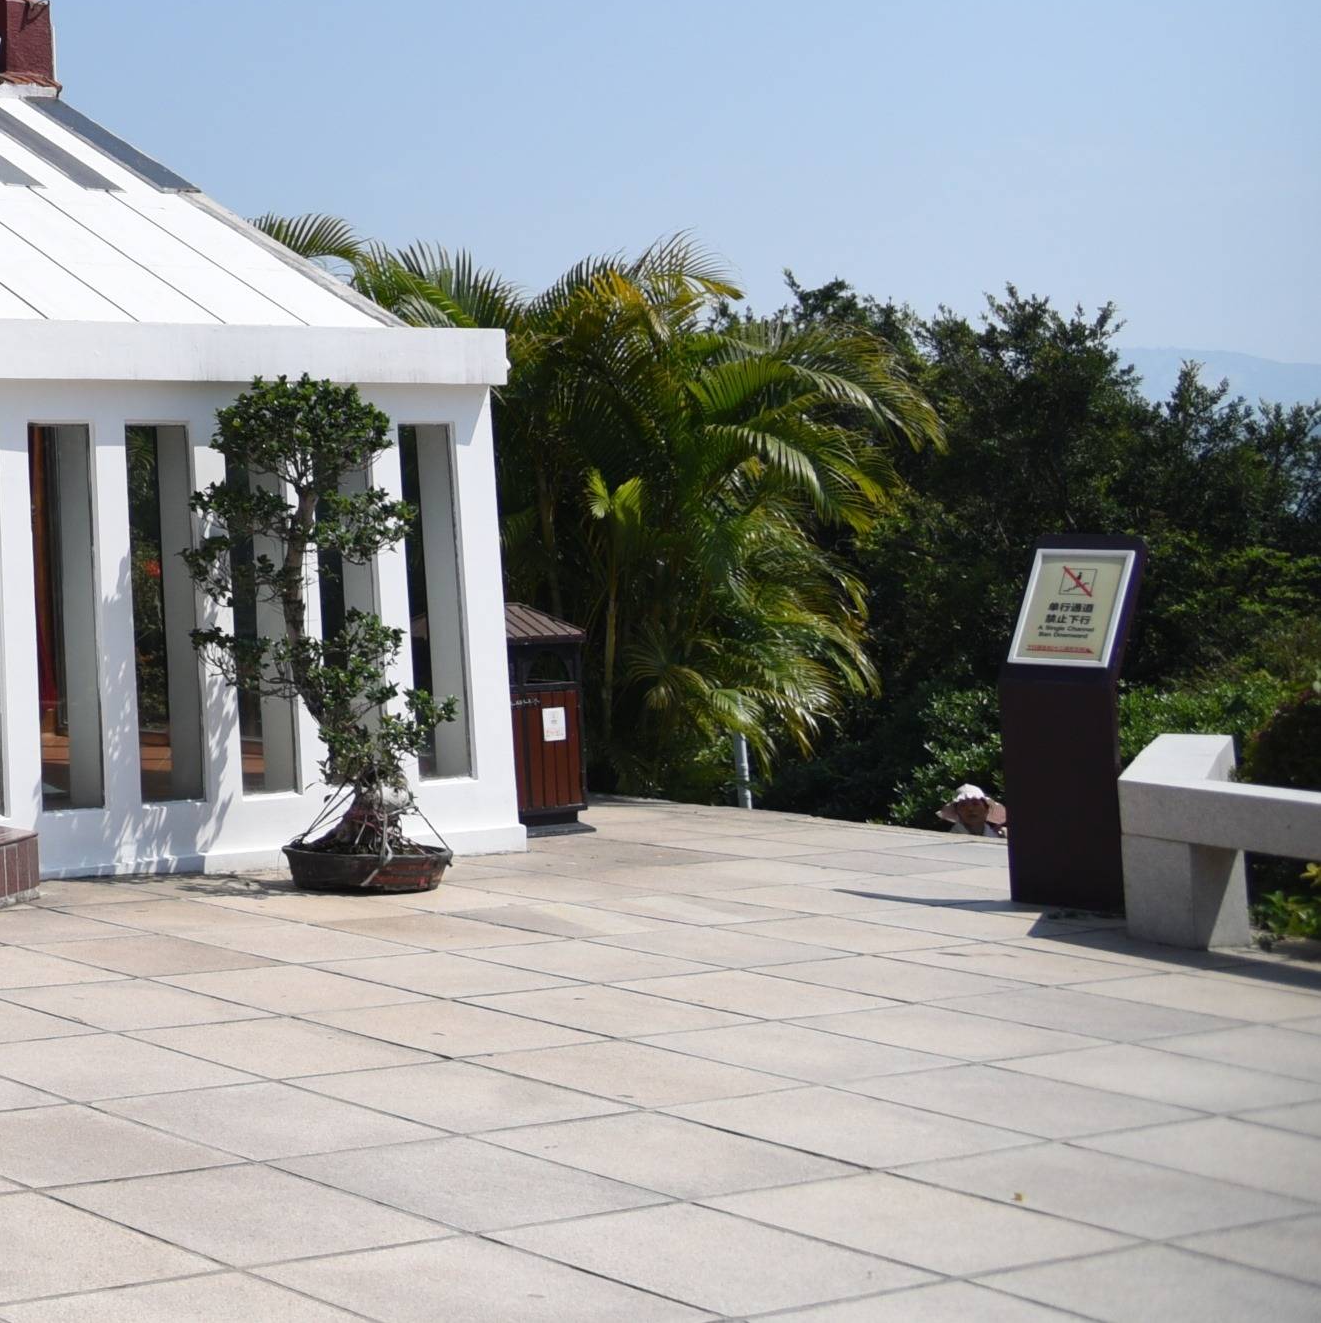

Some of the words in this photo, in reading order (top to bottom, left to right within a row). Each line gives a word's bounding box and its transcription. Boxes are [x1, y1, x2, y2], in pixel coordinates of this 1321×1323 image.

[1048, 602, 1094, 612] 单行通道
[1045, 614, 1091, 624] 禁止下行
